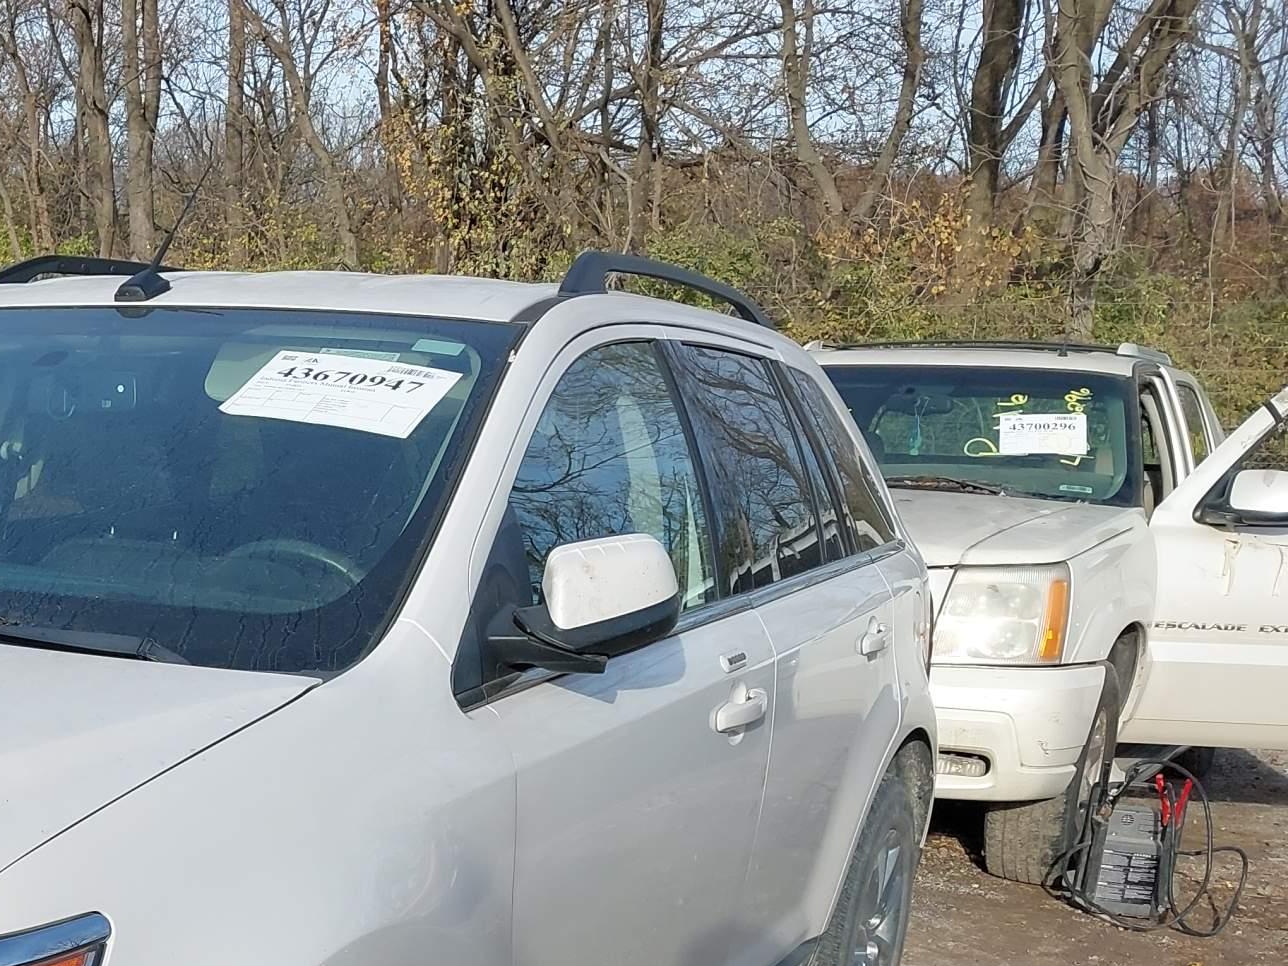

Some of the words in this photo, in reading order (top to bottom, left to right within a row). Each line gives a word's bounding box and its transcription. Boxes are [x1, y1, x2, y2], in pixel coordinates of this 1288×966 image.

[277, 366, 425, 394] 43670947
[1008, 422, 1076, 431] 43700296
[1153, 620, 1249, 632] ESCALADE
